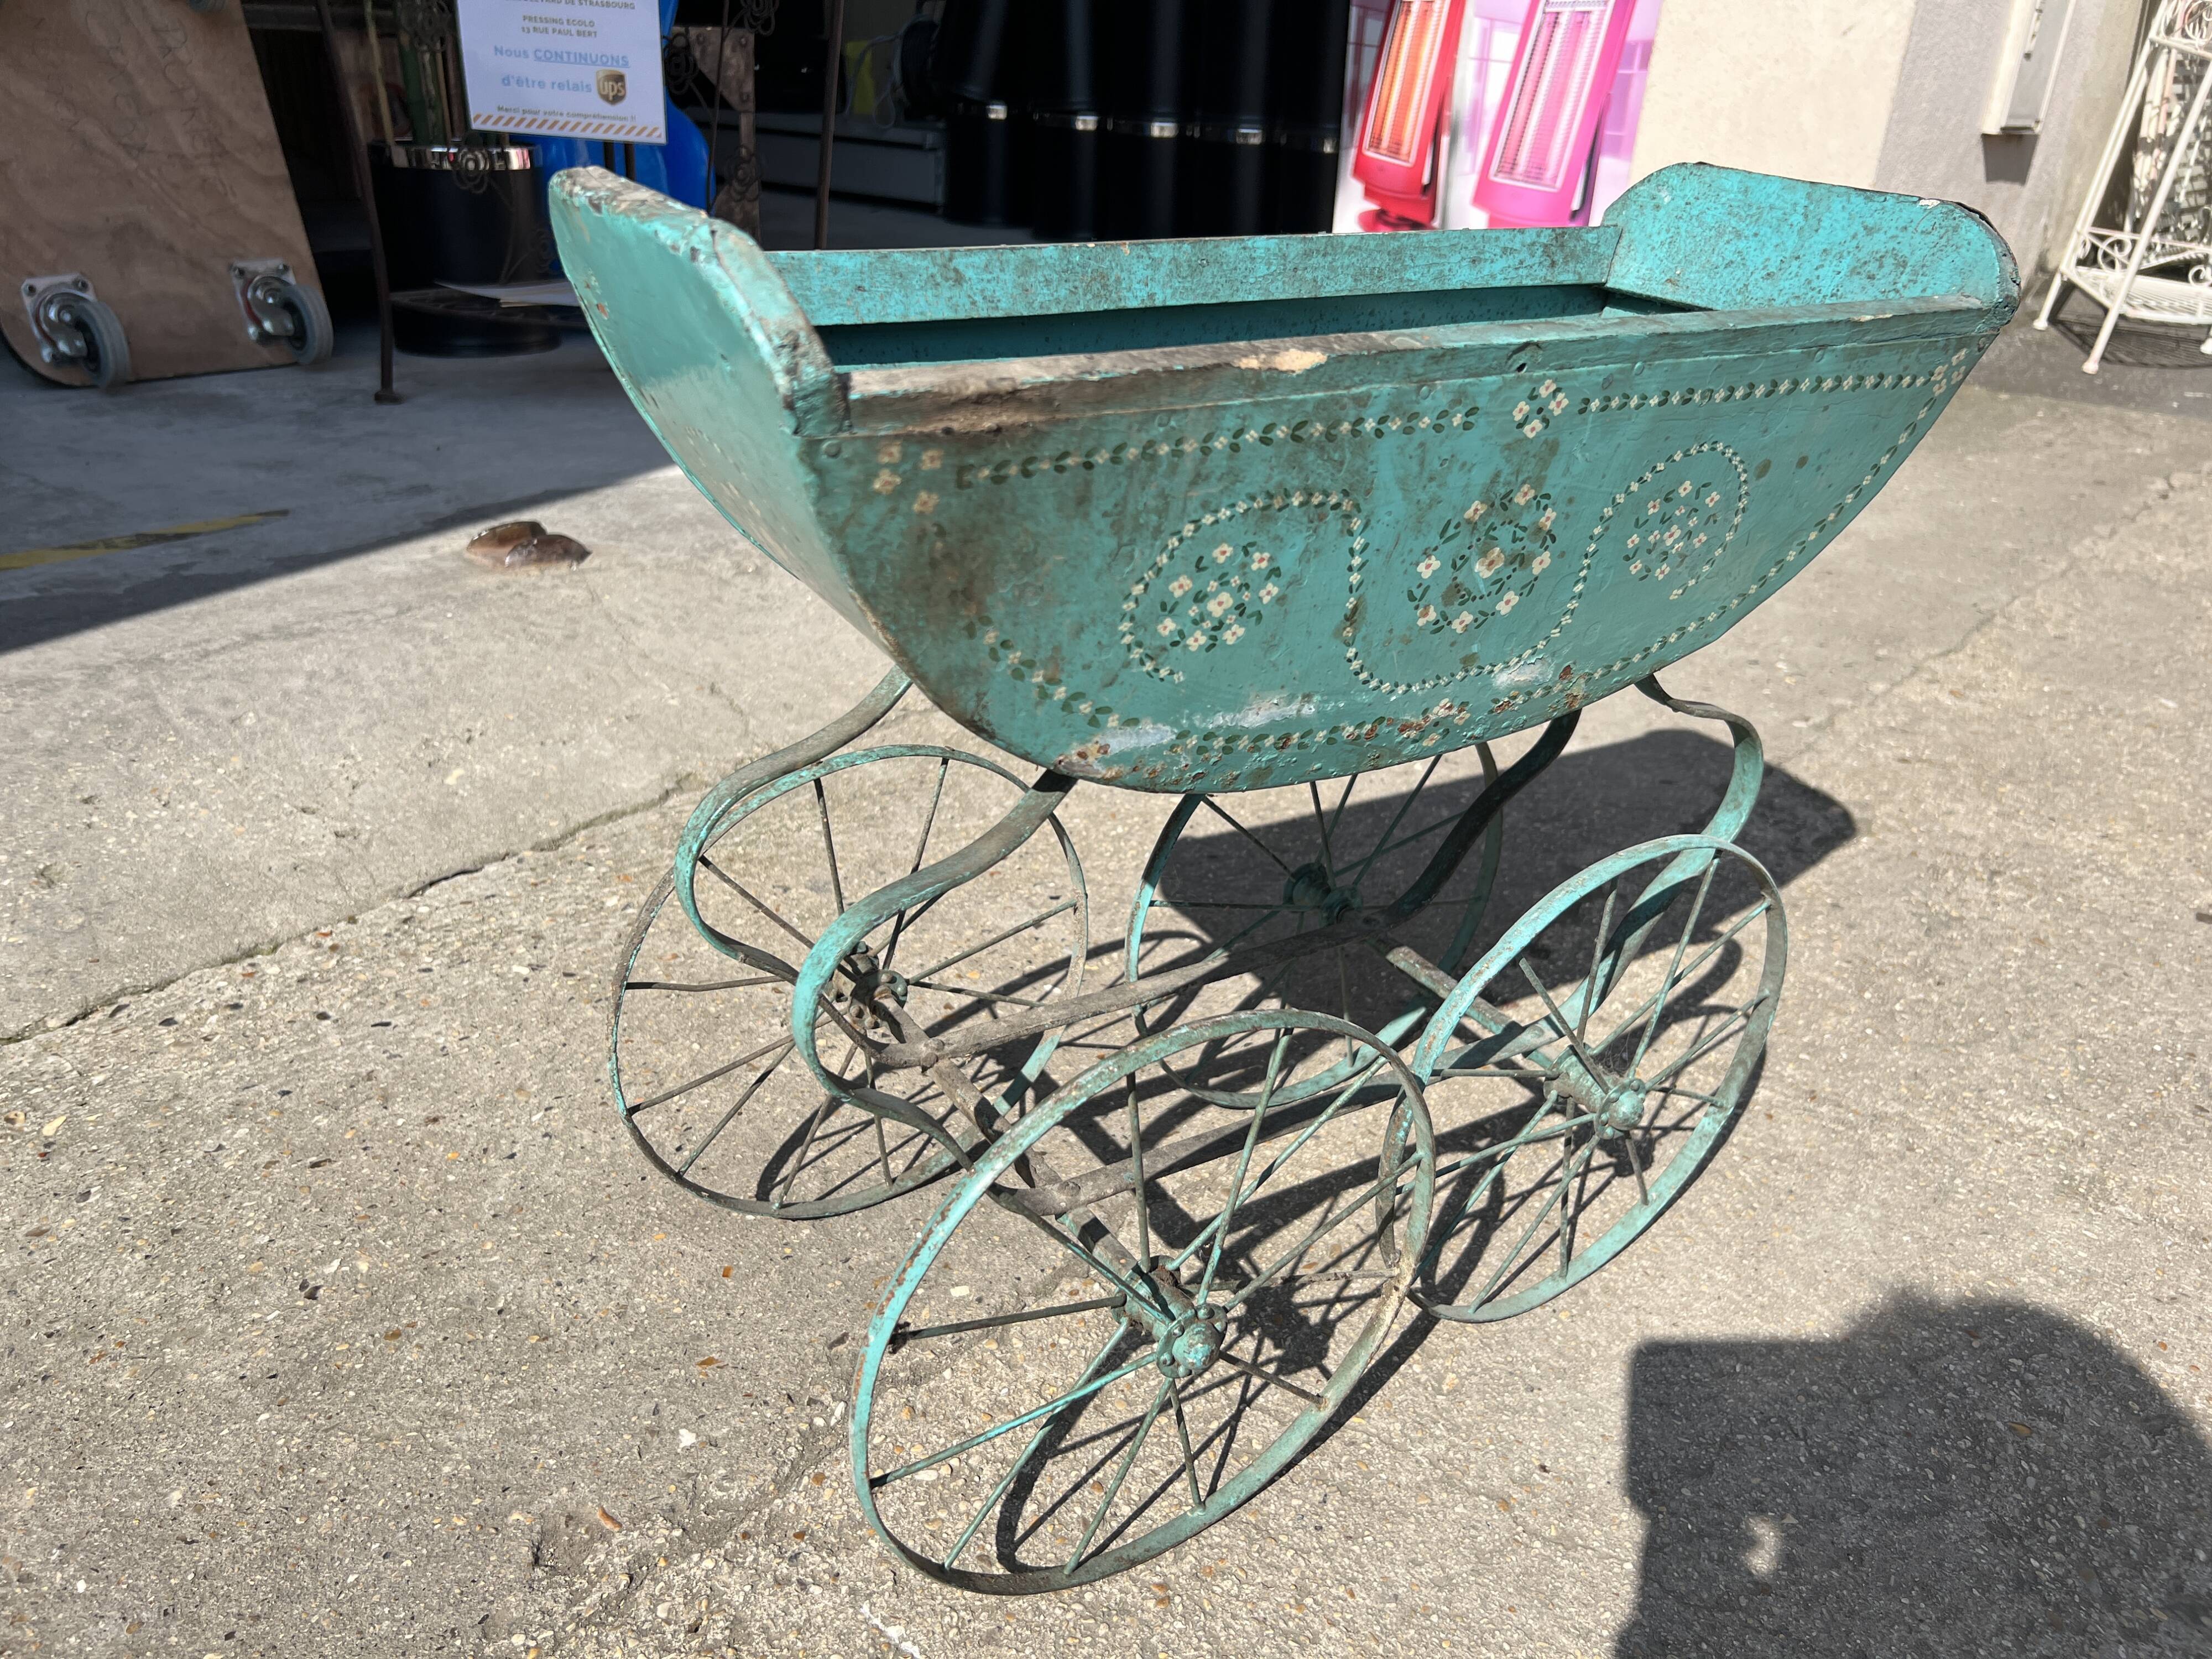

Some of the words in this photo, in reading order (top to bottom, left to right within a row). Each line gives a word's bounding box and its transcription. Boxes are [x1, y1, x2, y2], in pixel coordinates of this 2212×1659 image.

[578, 0, 635, 9] STRASBOURG
[523, 15, 564, 25] PRESSING
[566, 19, 595, 27] ECOLO
[552, 28, 574, 36] PAUL
[494, 45, 529, 59] Nous
[534, 49, 629, 67] CONTINUONS
[502, 74, 546, 89] d'être
[551, 79, 592, 93] relais
[497, 104, 520, 113] Merci
